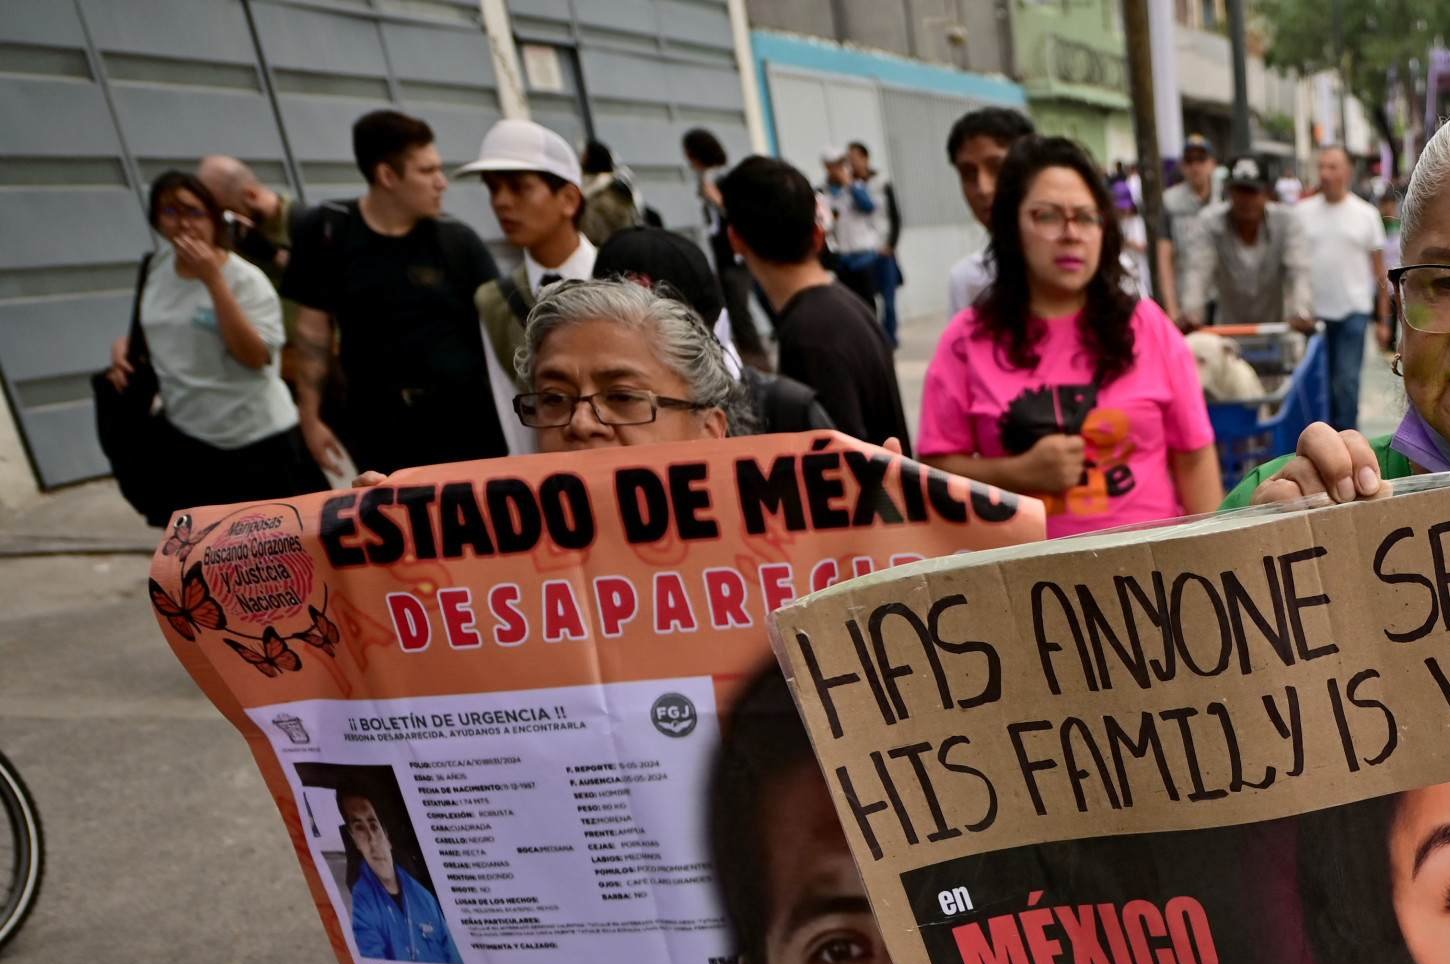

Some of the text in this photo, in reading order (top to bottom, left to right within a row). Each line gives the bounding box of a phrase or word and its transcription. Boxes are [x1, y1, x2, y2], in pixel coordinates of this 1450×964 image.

[319, 472, 595, 569] ESTADO
[614, 463, 720, 546] DE
[735, 438, 1020, 536] MÉXICO
[204, 534, 303, 565] Buscando Corazones
[220, 562, 291, 593] y Justicia
[236, 586, 302, 614] Nacional
[796, 593, 1001, 739] HAS
[1031, 545, 1341, 696] ANYONE
[361, 711, 427, 731] BOLETÍN
[431, 715, 454, 728] DE
[459, 706, 550, 726] URGENCIA
[656, 706, 690, 719] FGJ
[344, 733, 375, 743] PERSONA
[512, 722, 587, 735] ENCONTRARLA
[835, 735, 1000, 861] HIS
[1007, 686, 1305, 817] FAMILY
[1327, 668, 1399, 772] IS
[938, 885, 974, 916] en
